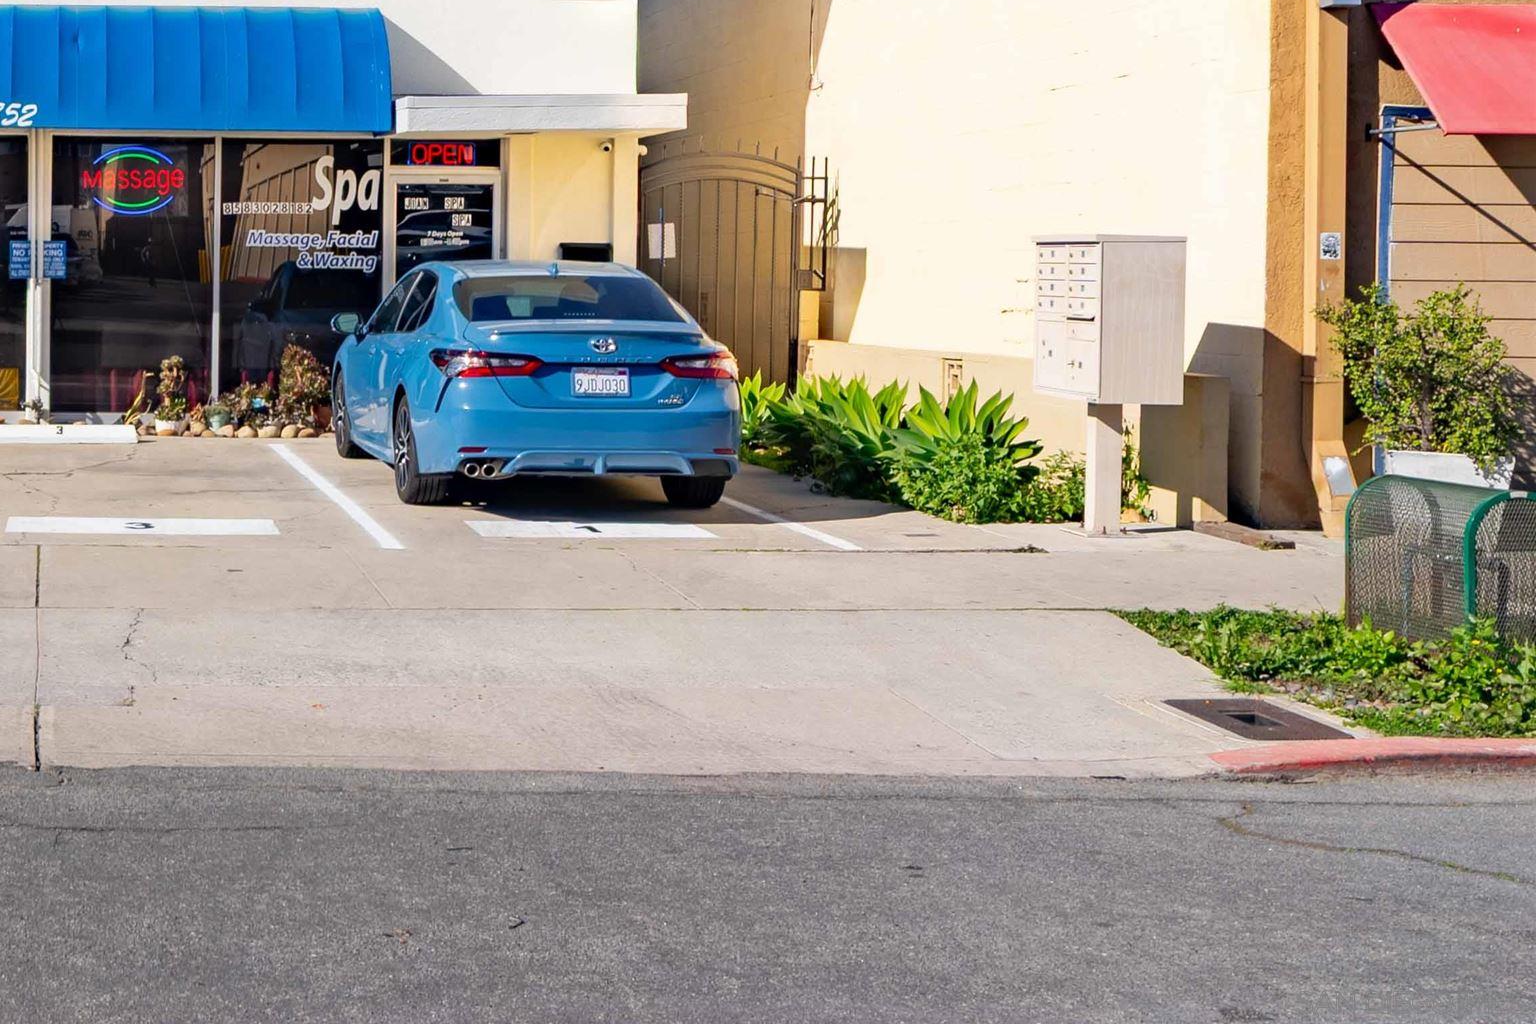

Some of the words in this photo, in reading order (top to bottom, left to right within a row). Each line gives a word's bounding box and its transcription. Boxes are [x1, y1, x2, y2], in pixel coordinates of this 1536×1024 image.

[412, 143, 473, 164] OPEN
[81, 167, 185, 195] Massage
[312, 155, 381, 226] Spa
[223, 202, 313, 215] 8583028182
[405, 197, 429, 210] JIAN
[444, 197, 465, 209] SPA
[452, 214, 472, 226] SPA
[246, 229, 325, 250] Massage,
[326, 230, 379, 249] Facial
[432, 230, 446, 238] Days
[447, 230, 464, 238] Open
[13, 249, 25, 257] NO
[297, 252, 314, 269] &
[314, 252, 377, 274] Waxing
[576, 378, 626, 392] 9JDJ030
[55, 425, 64, 435] 3
[124, 521, 155, 530] 3
